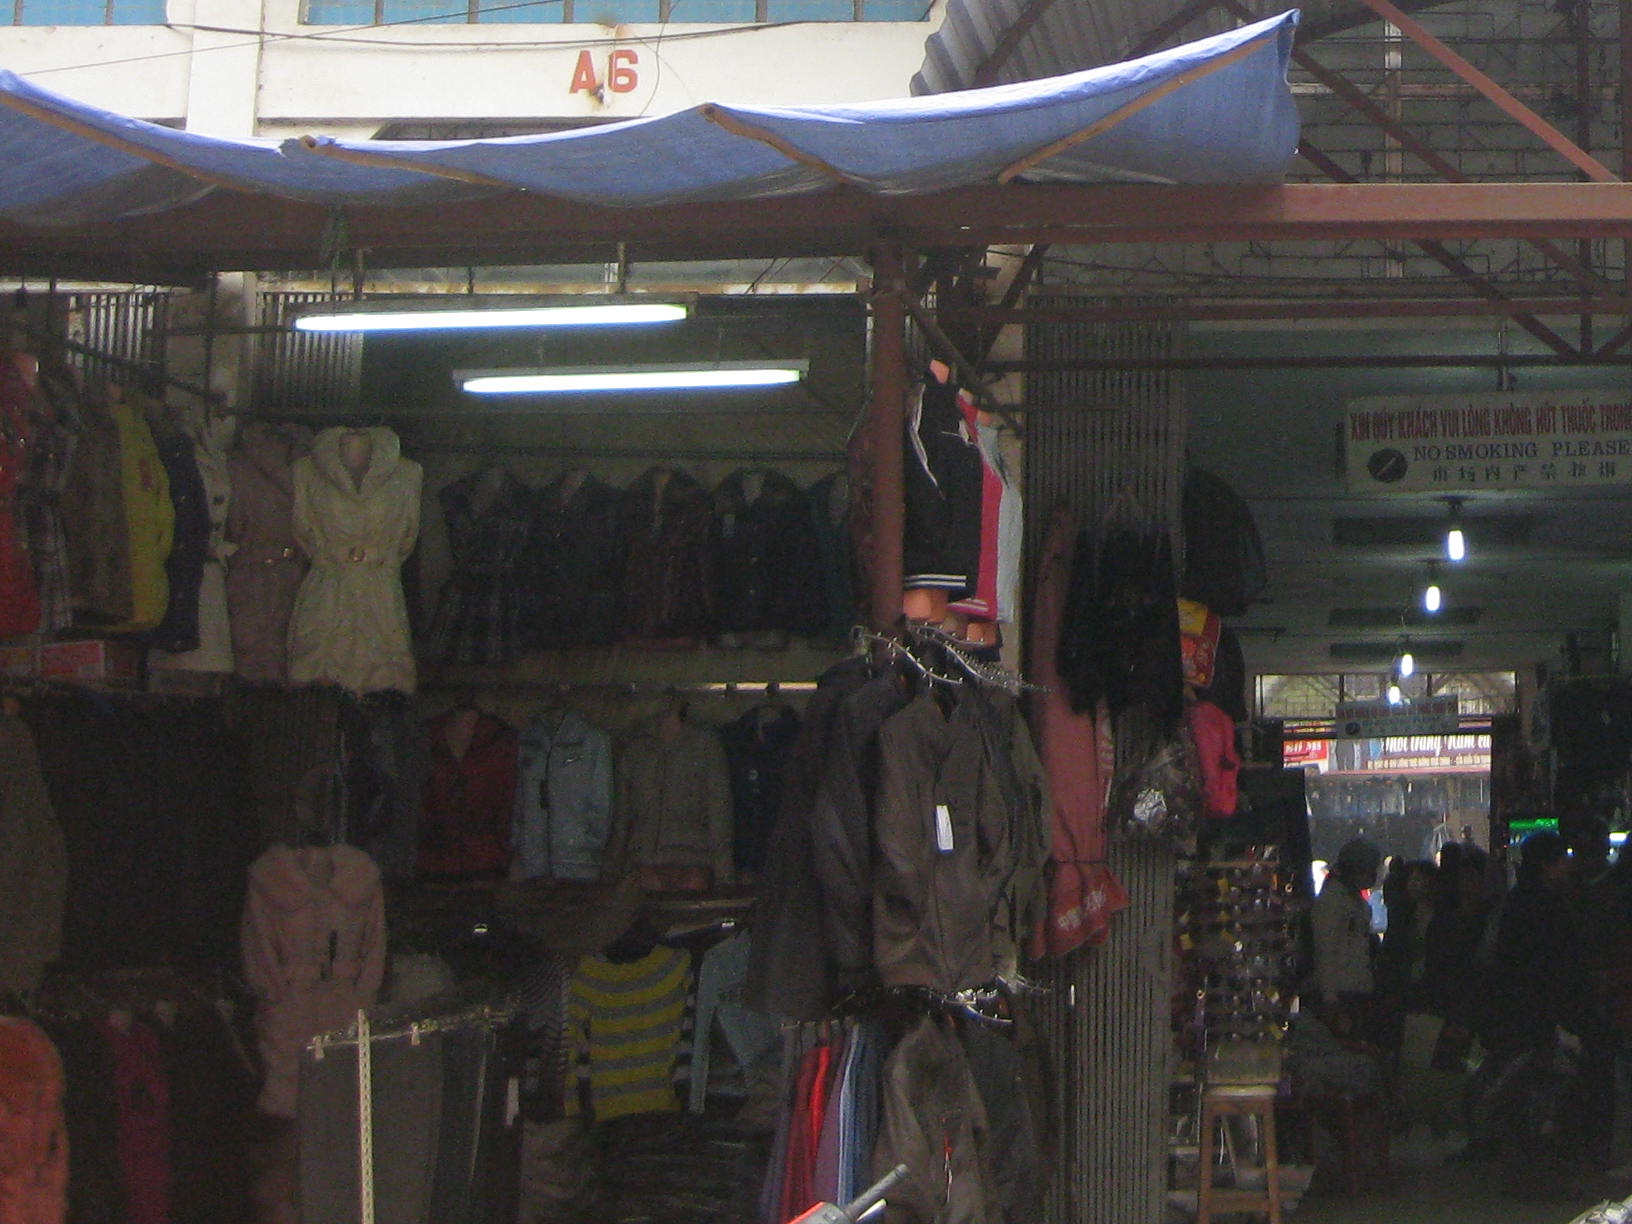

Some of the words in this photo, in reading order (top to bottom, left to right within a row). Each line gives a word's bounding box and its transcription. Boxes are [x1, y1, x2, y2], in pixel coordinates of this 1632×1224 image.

[569, 49, 638, 93] A6
[1413, 446, 1441, 461] NO
[1445, 442, 1538, 460] SMOKING
[1551, 439, 1632, 456] PLEASE
